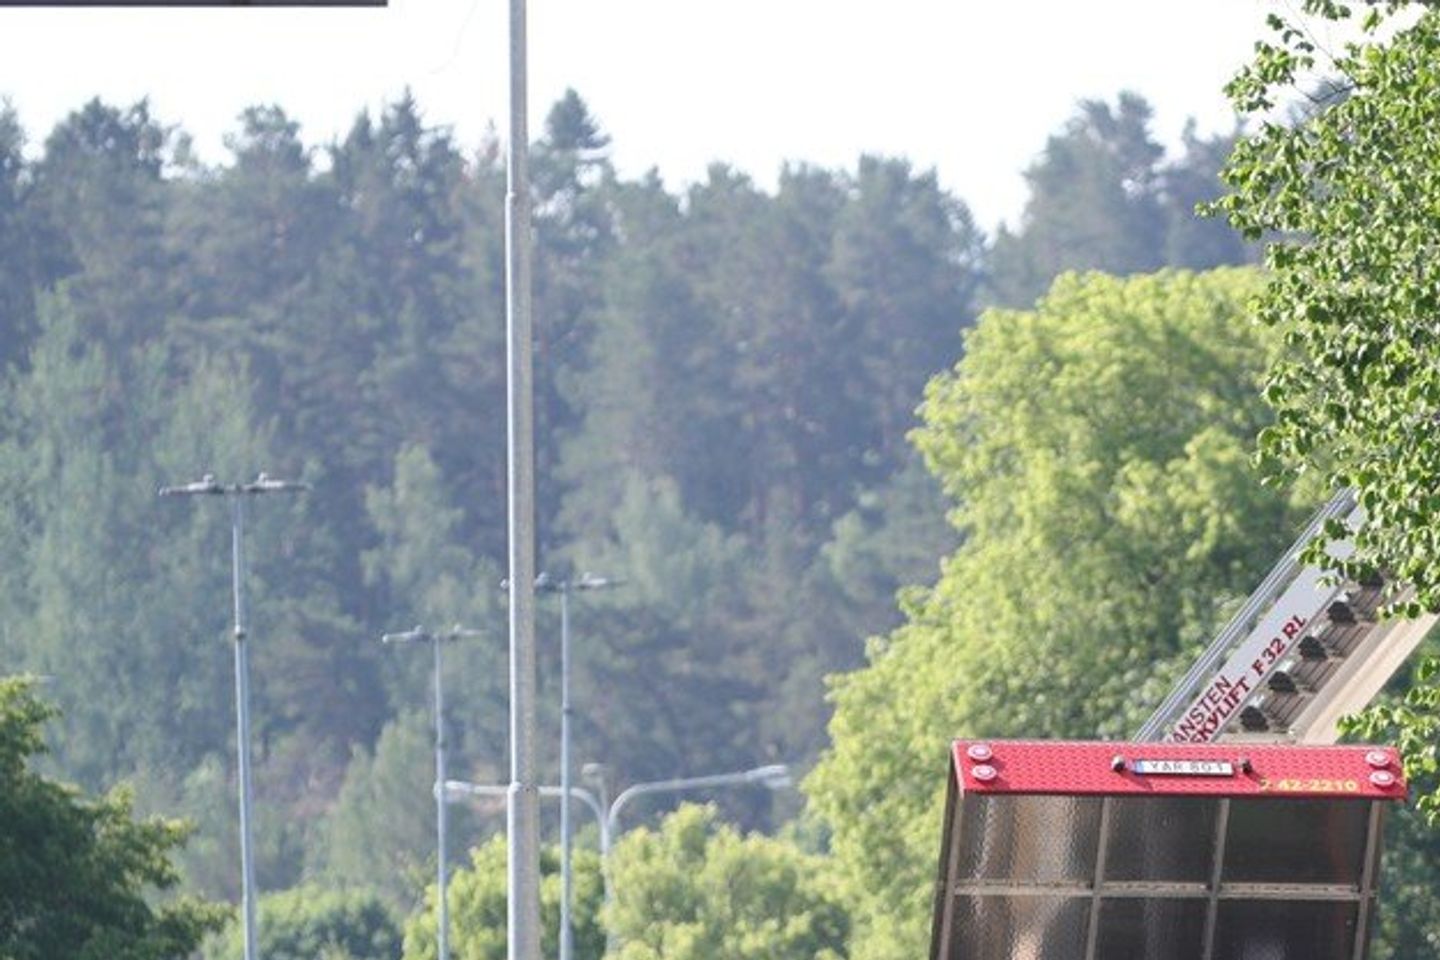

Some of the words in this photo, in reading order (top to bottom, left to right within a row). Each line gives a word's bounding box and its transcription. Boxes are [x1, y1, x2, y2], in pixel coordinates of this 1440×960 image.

[1168, 675, 1232, 742] ANSTEN
[1190, 676, 1251, 742] SKYLIFT
[1252, 658, 1265, 676] F
[1261, 637, 1286, 664] 32
[1282, 614, 1306, 640] RL
